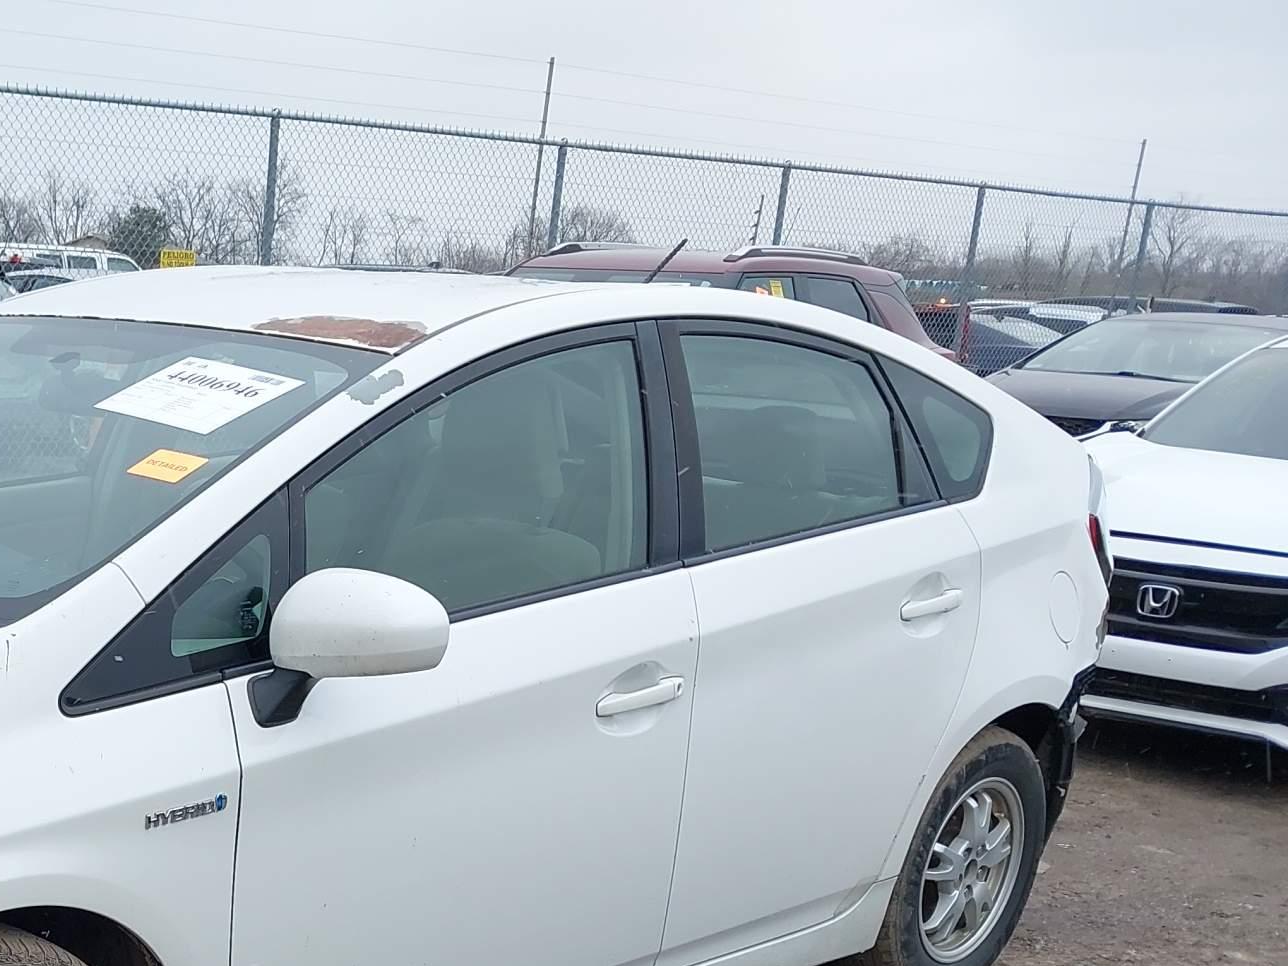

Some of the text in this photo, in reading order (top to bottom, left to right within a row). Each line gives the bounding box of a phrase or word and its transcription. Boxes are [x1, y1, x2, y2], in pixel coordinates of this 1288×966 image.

[167, 370, 264, 399] 44006946
[145, 458, 189, 473] DETAILED
[144, 799, 216, 830] HYBRID
